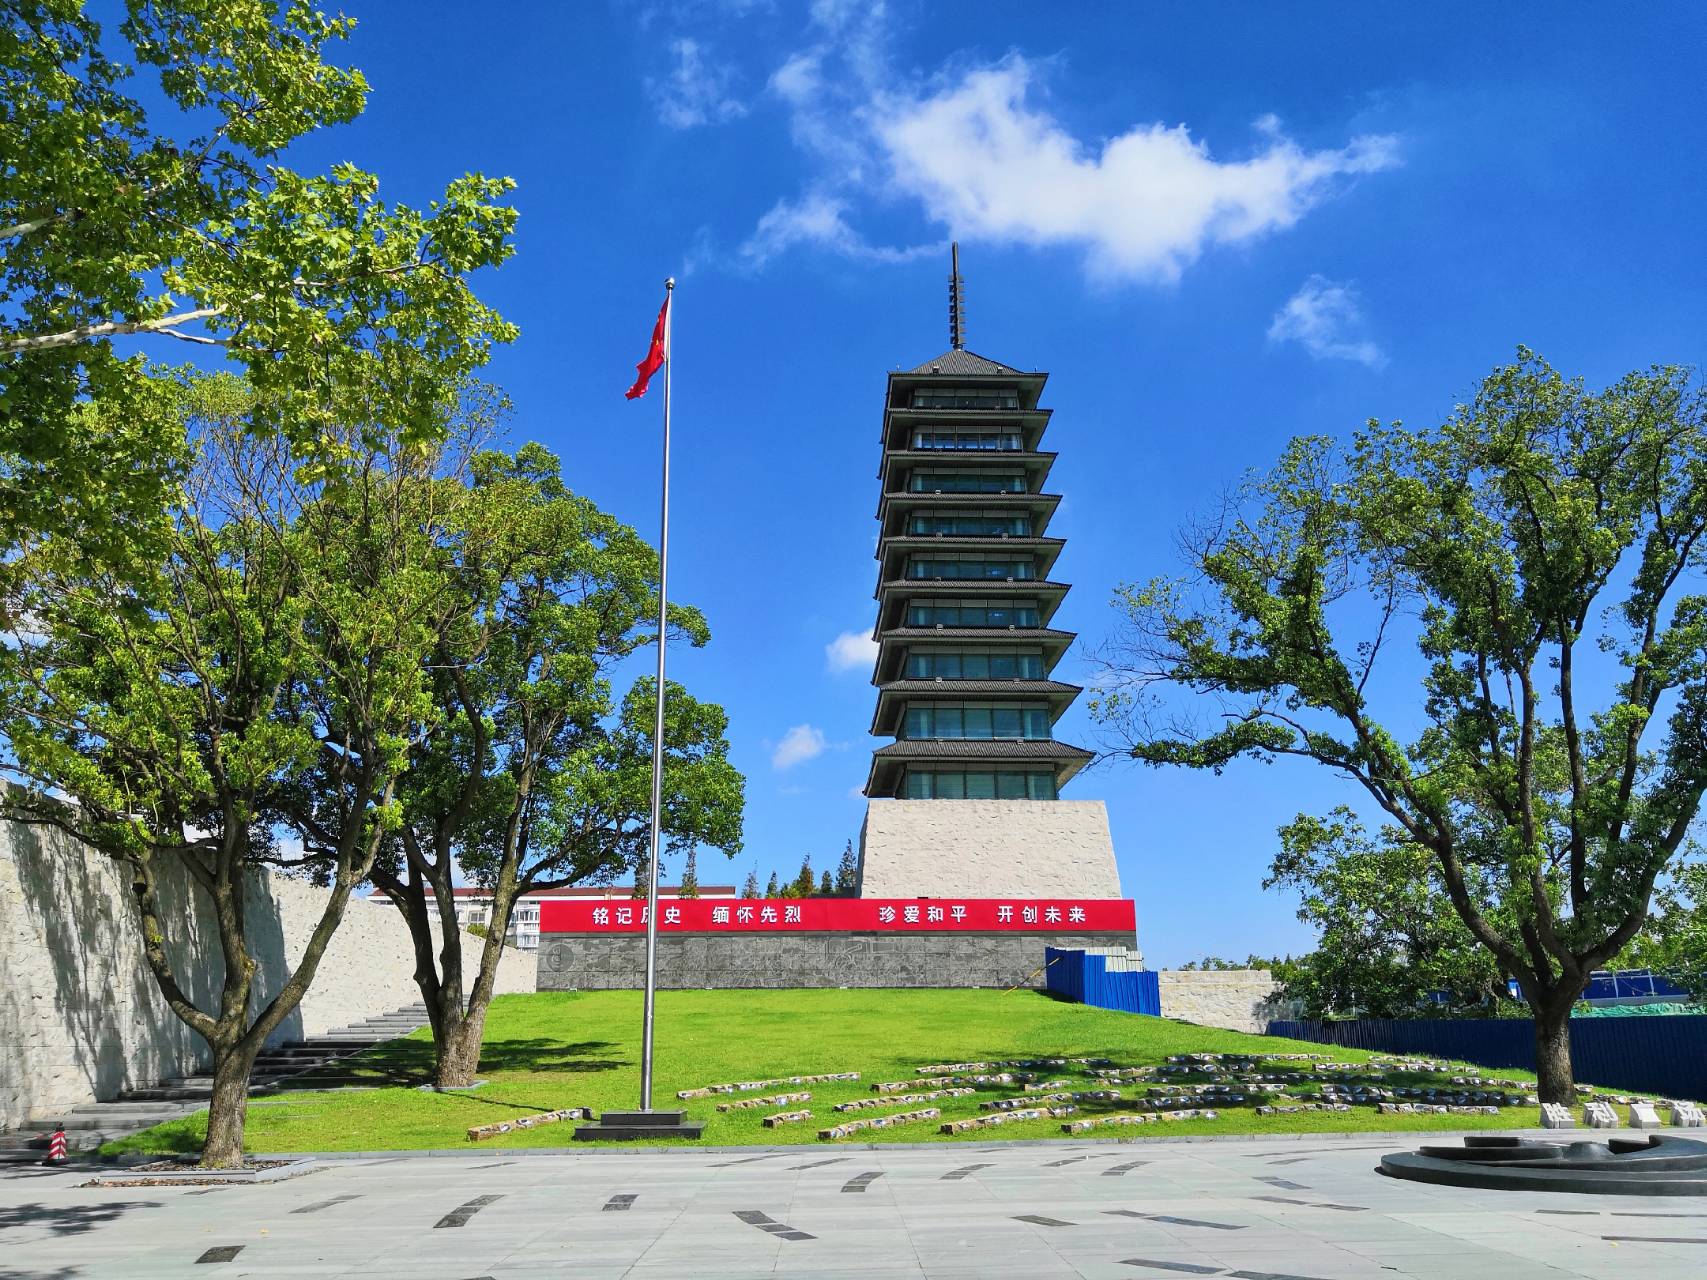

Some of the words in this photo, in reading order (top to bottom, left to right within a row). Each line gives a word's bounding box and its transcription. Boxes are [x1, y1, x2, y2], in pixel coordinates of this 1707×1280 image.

[712, 905, 801, 924] 缅怀先烈
[879, 905, 967, 923] 珍爱和平
[997, 905, 1086, 924] 开创未来
